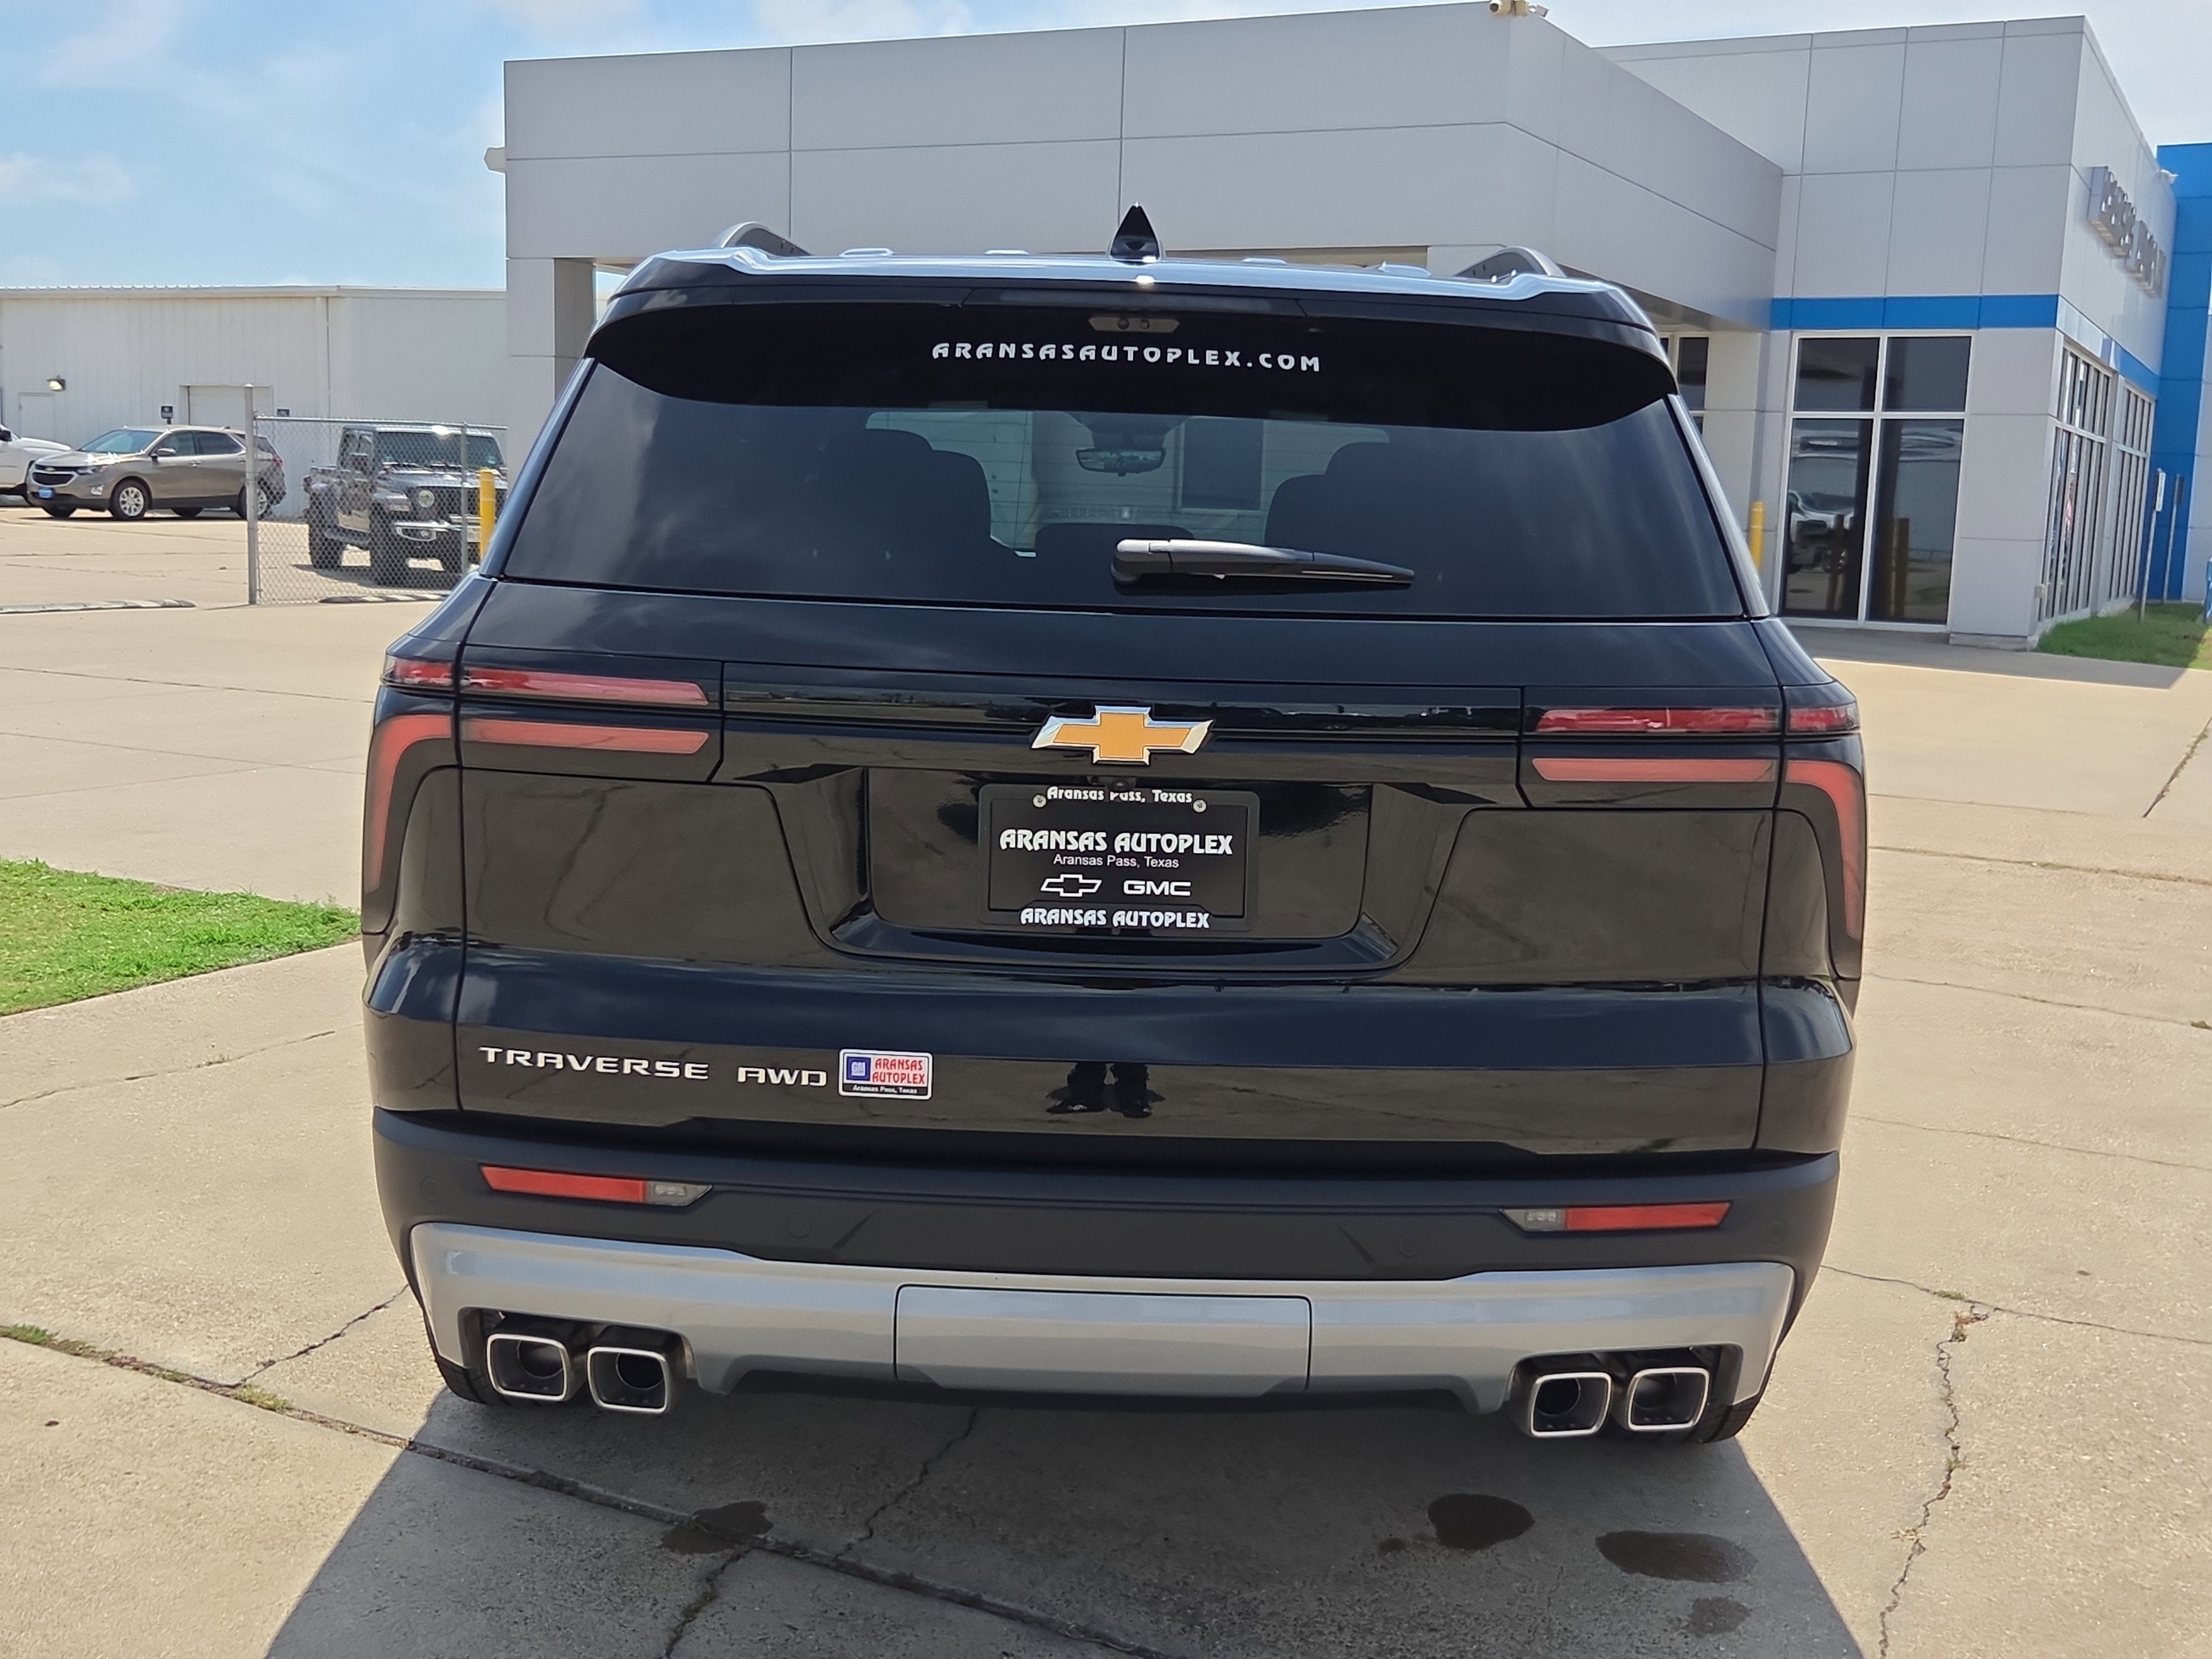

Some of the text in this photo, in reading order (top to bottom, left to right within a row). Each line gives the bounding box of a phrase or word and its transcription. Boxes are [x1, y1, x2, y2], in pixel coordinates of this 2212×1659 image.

[931, 342, 1320, 372] ARANSASAUTOPLEX.COM
[1047, 786, 1192, 803] Aransas Pass, Texas
[999, 828, 1233, 855] ARANSAS AUTOPLEX
[1053, 853, 1180, 869] Aransas Pass, Texas
[1123, 879, 1192, 897] GMC
[1020, 907, 1210, 929] ARANSAS AUTOPLEX
[478, 1046, 827, 1086] TRAVERSE AWD
[874, 1058, 924, 1071] ARANSAS
[872, 1071, 925, 1084] AUTOPLEX
